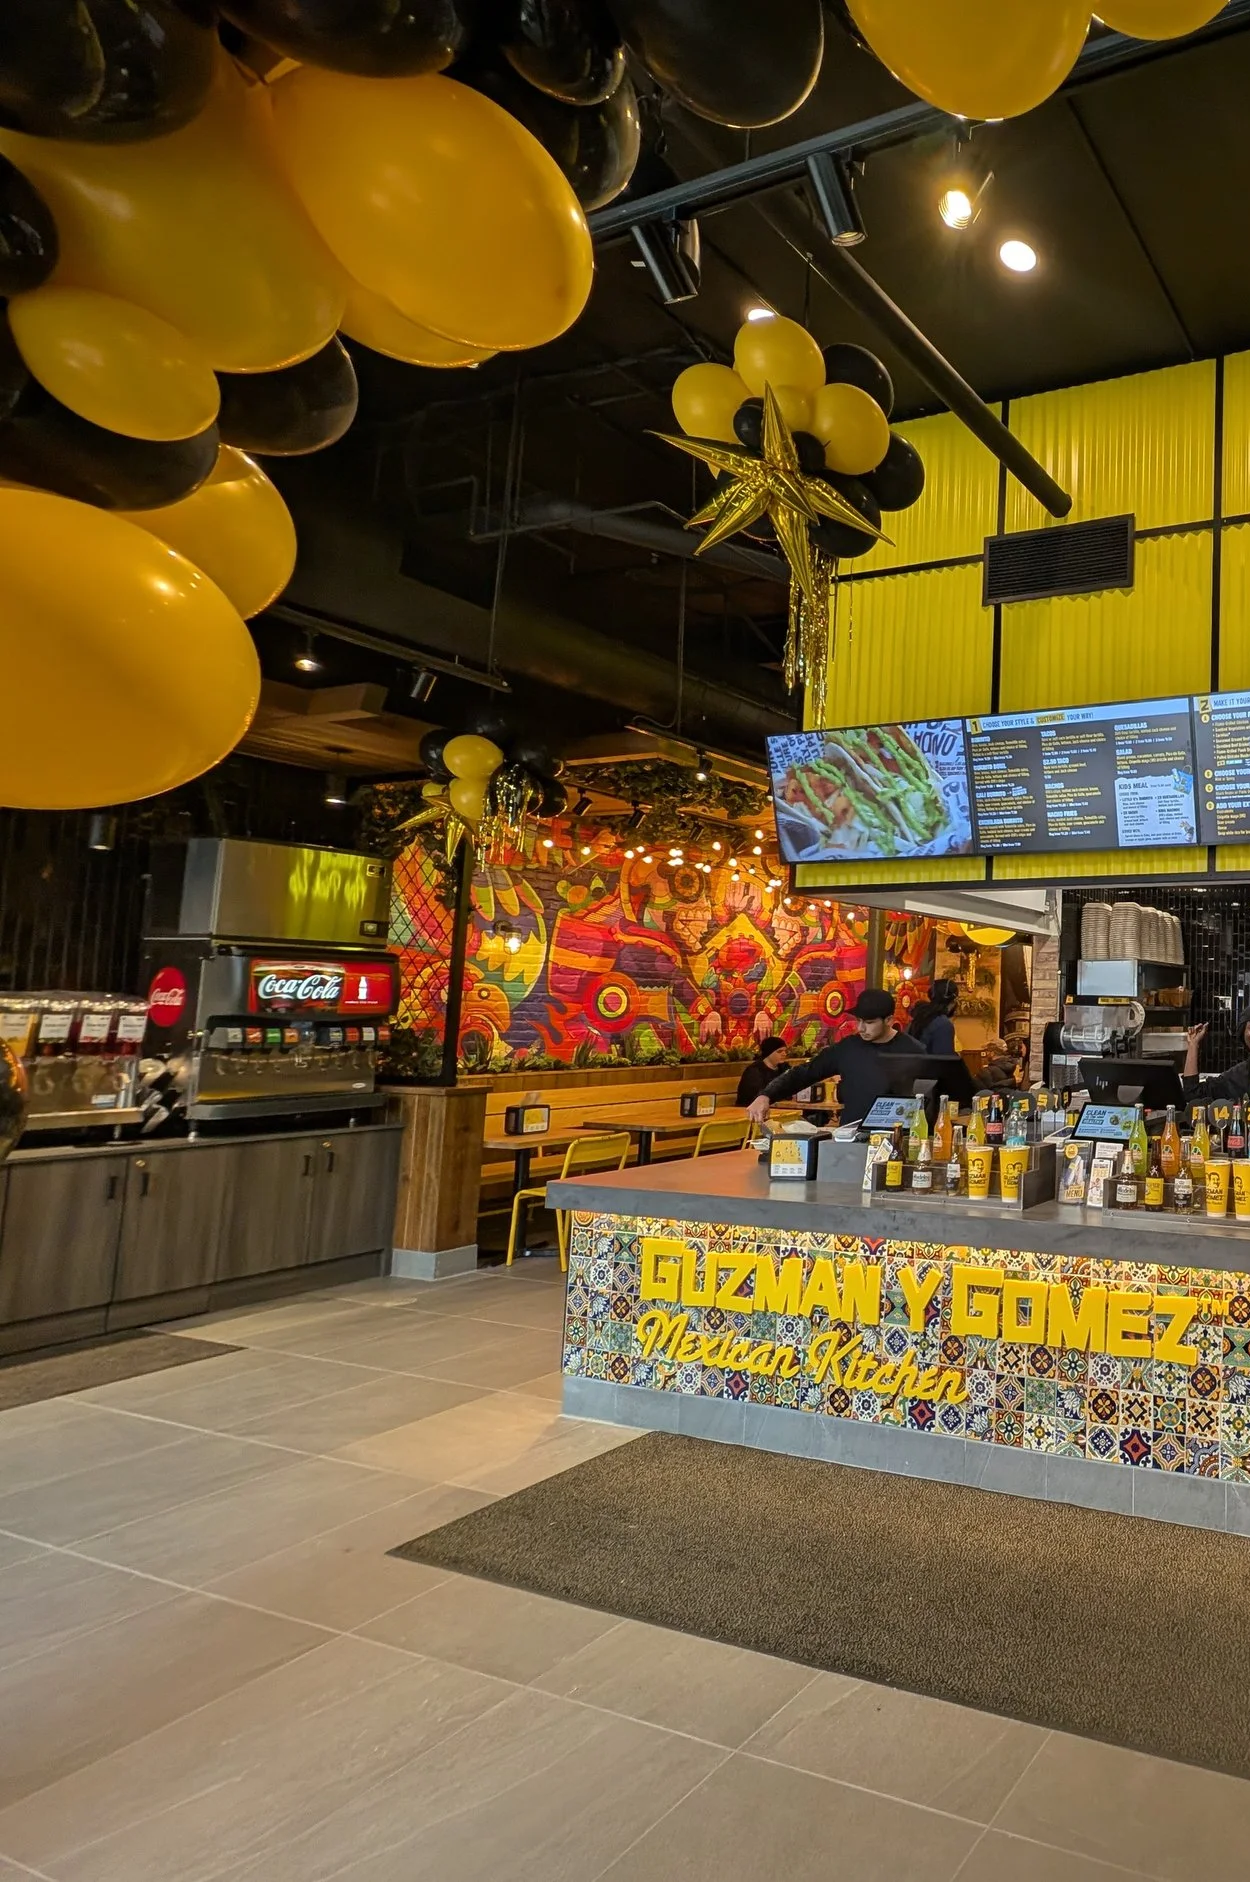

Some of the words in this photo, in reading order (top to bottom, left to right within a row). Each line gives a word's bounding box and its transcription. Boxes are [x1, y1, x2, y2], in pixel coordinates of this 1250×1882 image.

[1200, 700, 1209, 711] 2
[982, 721, 1000, 729] CHOOSE
[1001, 720, 1014, 728] YOUR
[1066, 713, 1080, 721] YOUR
[1212, 713, 1232, 721] CHOOSE
[258, 974, 343, 1000] Coca-Cola
[150, 988, 186, 1006] Coca-Cola
[1214, 1106, 1230, 1121] 14
[1066, 1190, 1083, 1198] MENU
[639, 1236, 883, 1326] GUZMAN
[897, 1267, 944, 1333] Y
[952, 1263, 1198, 1367] GOMEZ
[636, 1310, 801, 1379] Mexican
[807, 1331, 968, 1405] Kitchen
